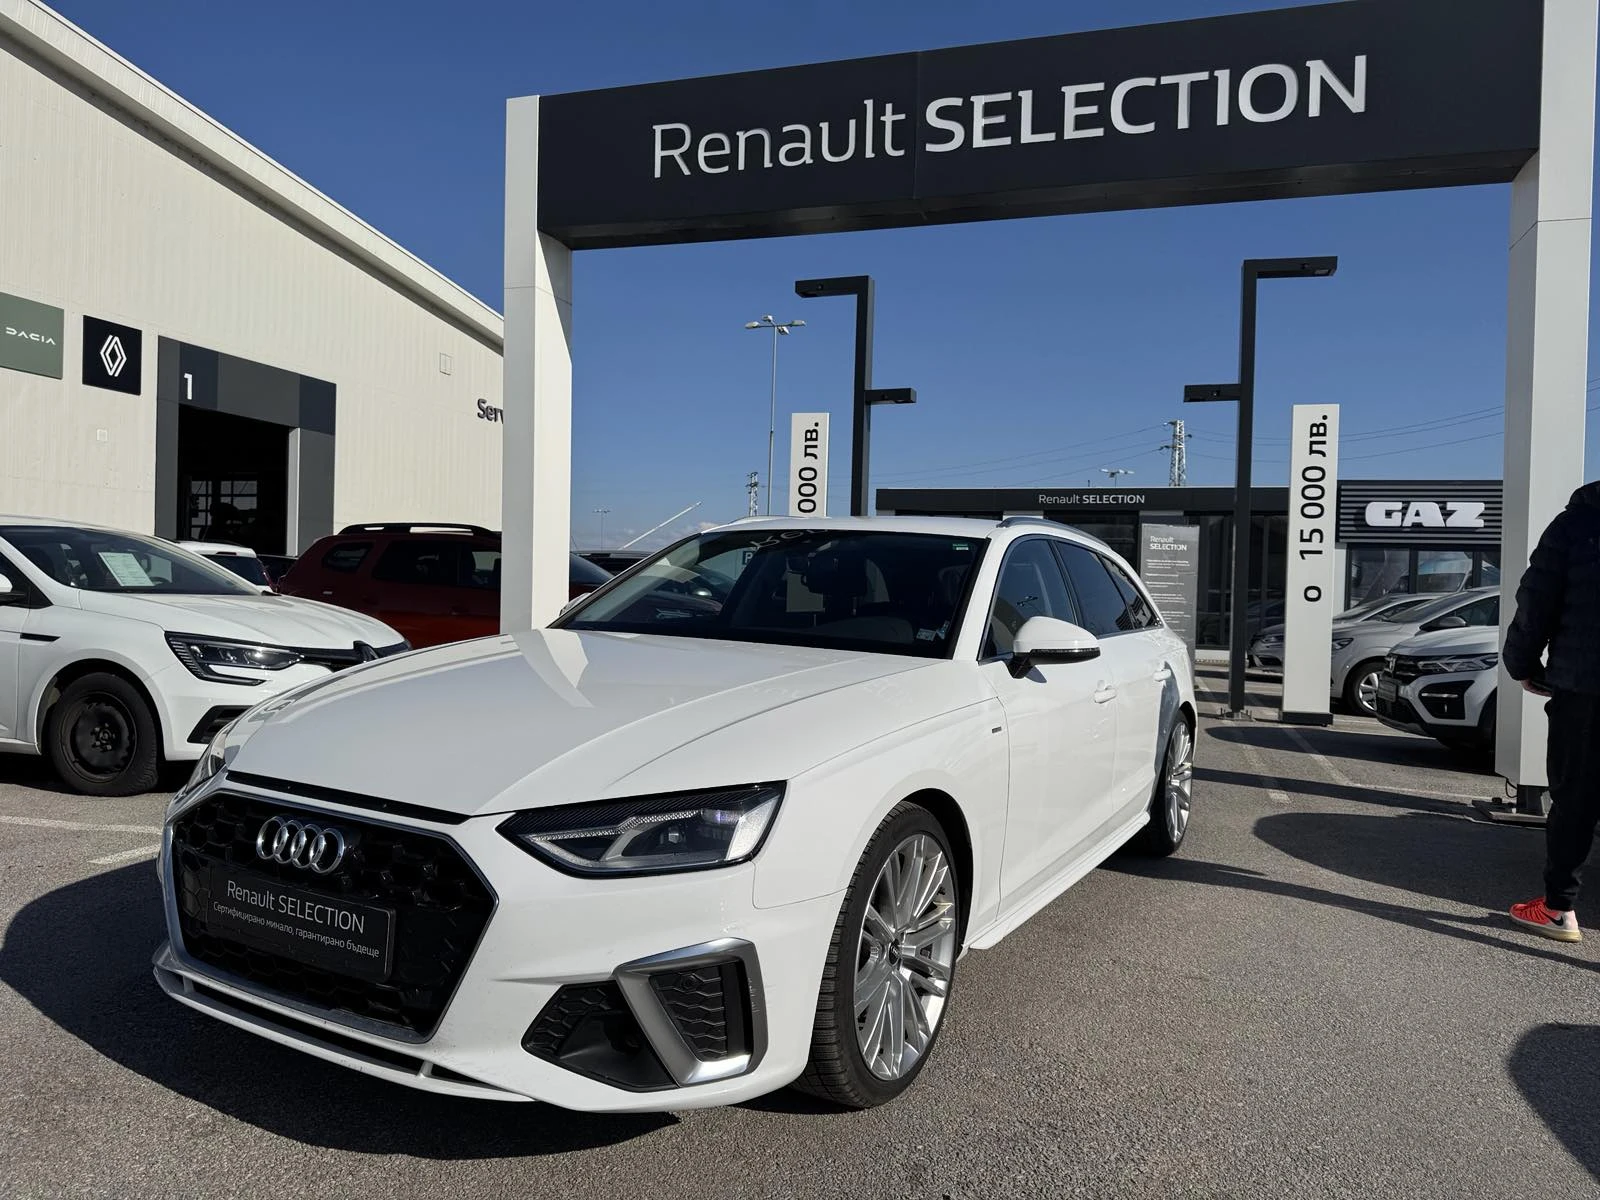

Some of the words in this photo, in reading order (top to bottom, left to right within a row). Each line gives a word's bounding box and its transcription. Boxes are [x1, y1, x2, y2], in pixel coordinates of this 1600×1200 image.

[653, 99, 906, 178] Renault
[925, 54, 1367, 153] SELECTION
[6, 326, 56, 346] DACIA
[184, 372, 192, 400] 1
[804, 422, 819, 460] лв.
[1309, 414, 1328, 457] лв.
[798, 467, 818, 513] 000
[1038, 494, 1081, 504] Renault
[1082, 495, 1145, 504] SELECTION
[1300, 466, 1326, 519] 000
[1365, 501, 1485, 527] GAZ
[1149, 543, 1188, 551] SELECTION
[1299, 528, 1324, 560] 15
[227, 880, 275, 911] Renault
[278, 895, 365, 934] SELECTION
[213, 901, 265, 926] Сертифицирано
[295, 927, 346, 949] гарантирано
[346, 939, 380, 959] бъдеще
